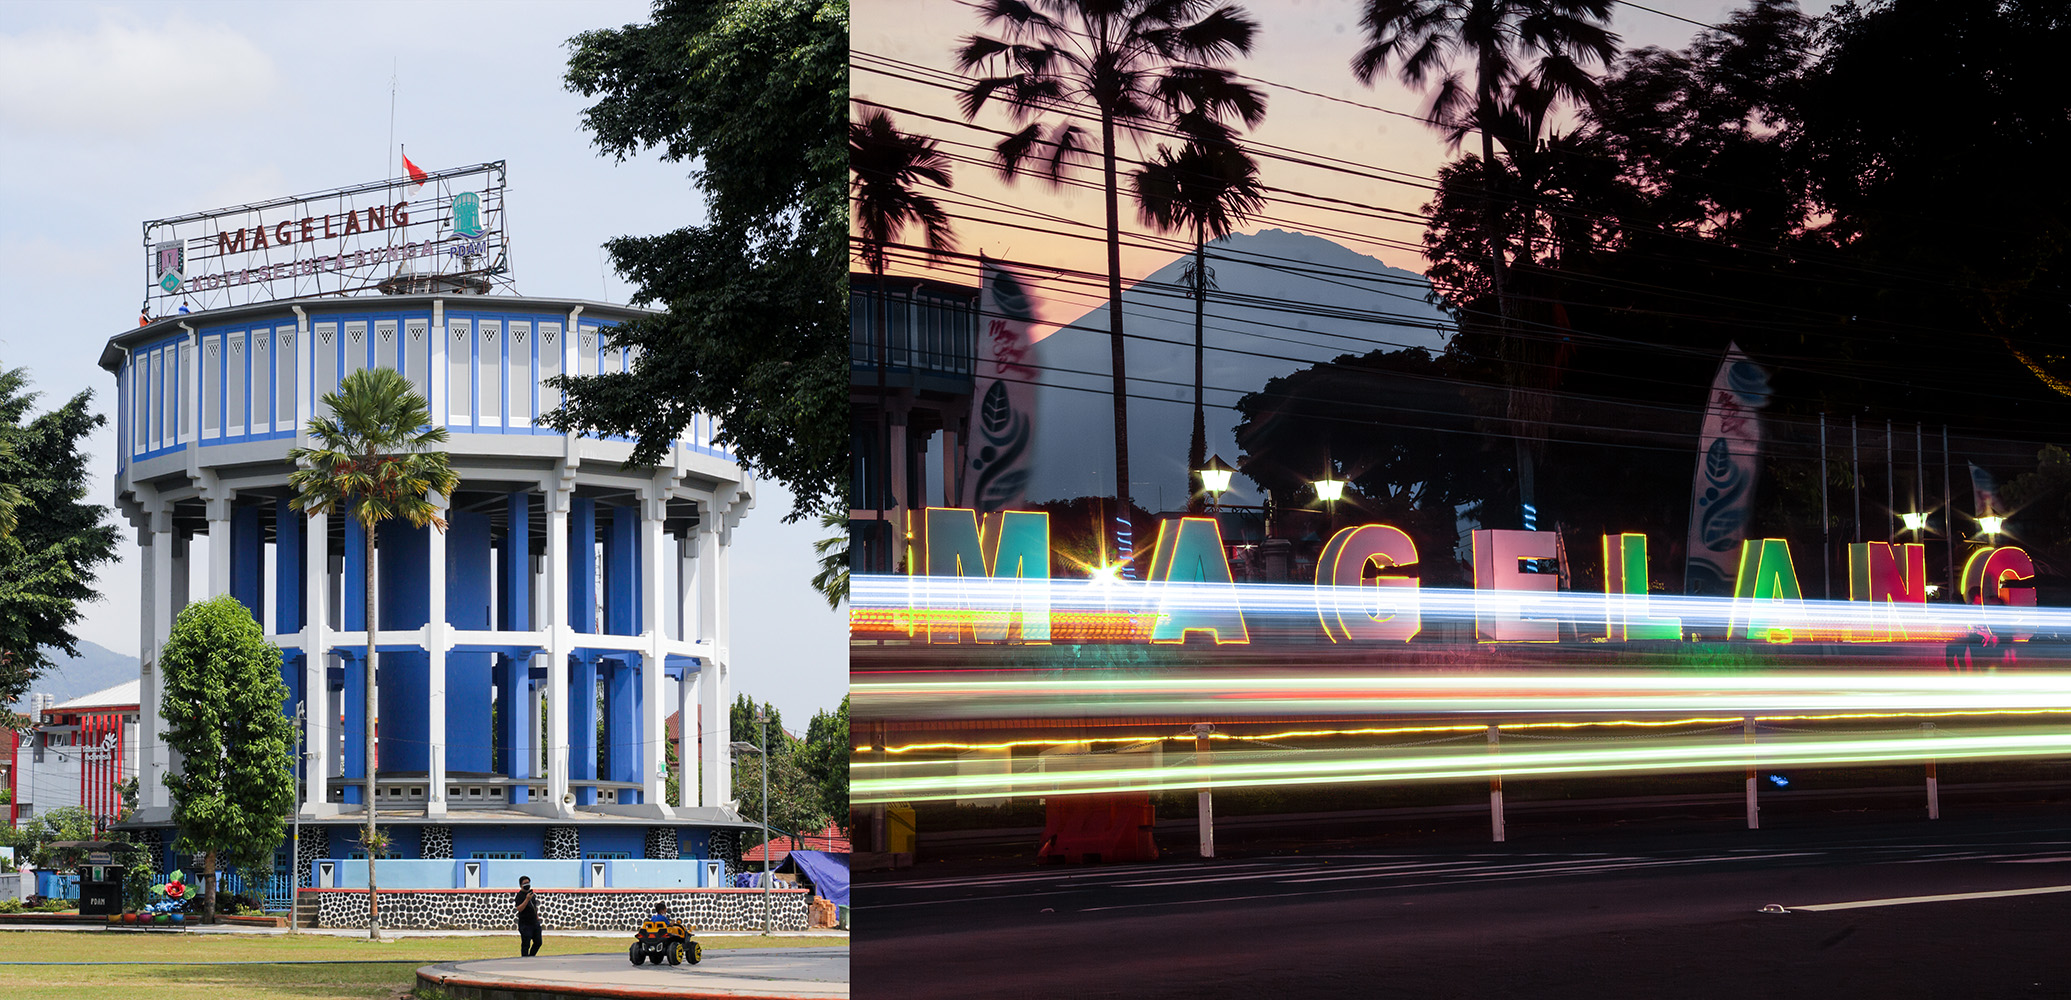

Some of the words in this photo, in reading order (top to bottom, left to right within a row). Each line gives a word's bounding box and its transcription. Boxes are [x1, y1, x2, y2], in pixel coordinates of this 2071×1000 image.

[219, 201, 410, 257] MAGELANG
[450, 241, 487, 259] PDAM
[192, 268, 251, 292] KOTA
[258, 254, 347, 282] SEJUTA
[354, 239, 434, 267] BUNGA
[908, 506, 2038, 646] MAGELANG
